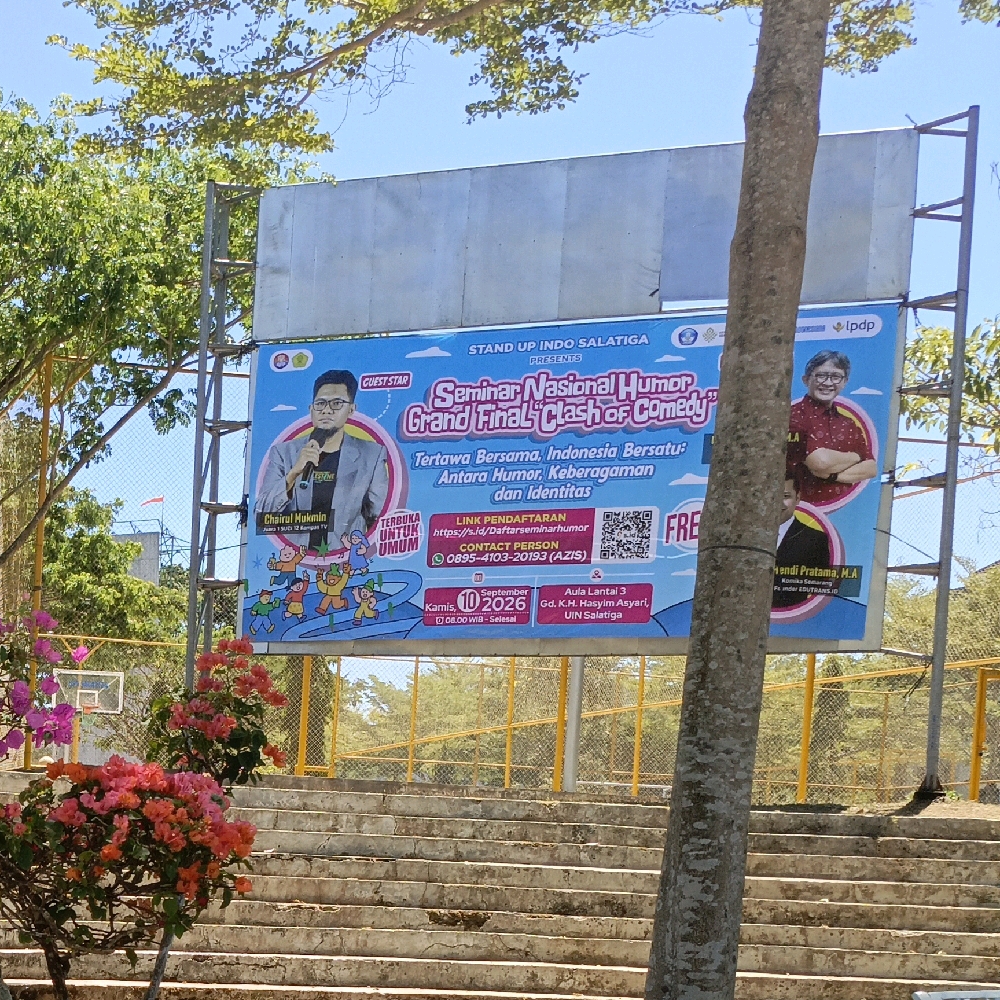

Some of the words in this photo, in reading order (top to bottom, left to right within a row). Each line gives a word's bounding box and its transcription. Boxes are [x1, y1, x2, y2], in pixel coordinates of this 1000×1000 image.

[846, 319, 875, 333] lpdp
[468, 342, 514, 355] STAND
[517, 341, 536, 352] UP
[540, 339, 574, 351] INDO
[578, 334, 649, 348] SALATIGA
[530, 354, 582, 365] PRESENTS
[362, 376, 387, 387] GUEST
[388, 375, 409, 386] STAR
[434, 381, 521, 408] Seminar
[523, 373, 615, 401] Nasional
[618, 373, 693, 400] Humor
[408, 404, 470, 432] Grand
[605, 407, 630, 422] of
[415, 452, 471, 467] Tertawa
[475, 449, 542, 464] Bersama,
[547, 443, 618, 461] Indonesia
[622, 442, 687, 458] Bersatu:
[438, 469, 488, 485] Antara
[491, 467, 543, 482] Humor,
[548, 464, 655, 483] Keberagaman
[494, 486, 522, 501] dan
[527, 483, 592, 500] Identitas
[264, 513, 293, 525] Chairul
[295, 512, 327, 523] Mukmin
[381, 513, 421, 529] TERBUKA
[456, 516, 481, 526] LINK
[484, 513, 567, 525] PENDAFTARAN
[379, 524, 419, 542] UNTUK
[433, 524, 589, 538] https://s.id/Daftarseminarhumor
[665, 510, 701, 544] FRE
[378, 537, 419, 557] UMUM
[459, 542, 511, 553] CONTACT
[513, 540, 559, 551] PERSON
[446, 551, 548, 564] 0895-4103-20193
[549, 550, 588, 563] (AZIS)
[799, 565, 839, 579] Pratama,
[841, 567, 858, 579] M.A
[481, 588, 529, 597] September
[564, 587, 586, 596] Aula
[588, 587, 618, 596] Lantai
[619, 587, 627, 595] 3
[425, 602, 457, 612] Kamis,
[461, 591, 477, 610] 10
[481, 597, 527, 612] 2026
[540, 600, 557, 608] Gd.
[558, 599, 578, 608] K.H.
[579, 599, 615, 609] Hasyim
[616, 598, 649, 608] Asyari,
[489, 615, 517, 623] Selesai
[564, 611, 582, 620] UIN
[583, 611, 623, 621] Salatiga
